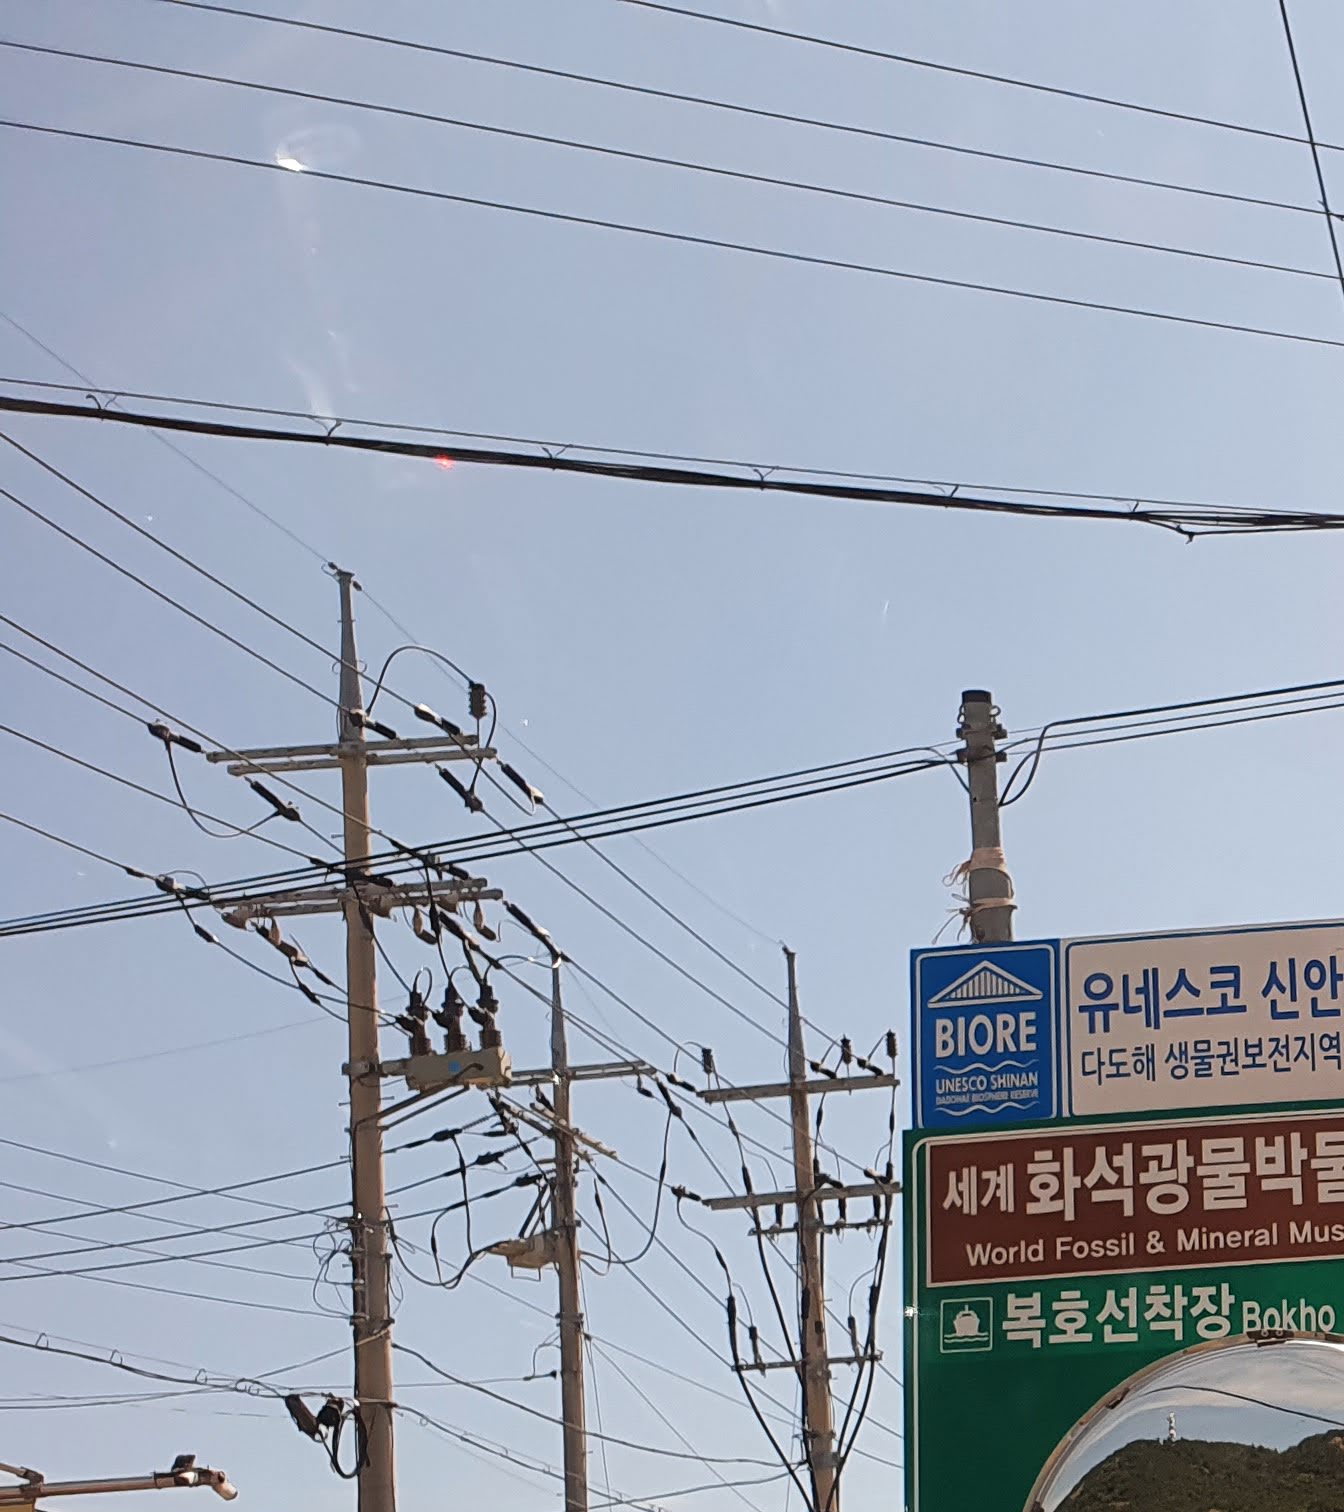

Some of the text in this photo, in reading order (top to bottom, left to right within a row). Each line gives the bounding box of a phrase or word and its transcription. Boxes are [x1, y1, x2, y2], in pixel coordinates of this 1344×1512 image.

[1078, 954, 1344, 1035] 유네스코 신안
[934, 1011, 1038, 1059] BIORE
[1081, 1030, 1343, 1086] 다도해 생물권보전지역
[935, 1070, 1039, 1094] UNESCO SHINAN
[943, 1163, 1015, 1215] 세계
[966, 1238, 1046, 1266] World
[1055, 1231, 1135, 1260] Fossil
[1146, 1230, 1165, 1254] &
[1177, 1222, 1279, 1252] Mineral
[1001, 1283, 1236, 1349] 복호선착장
[1242, 1298, 1336, 1333] Bokho
